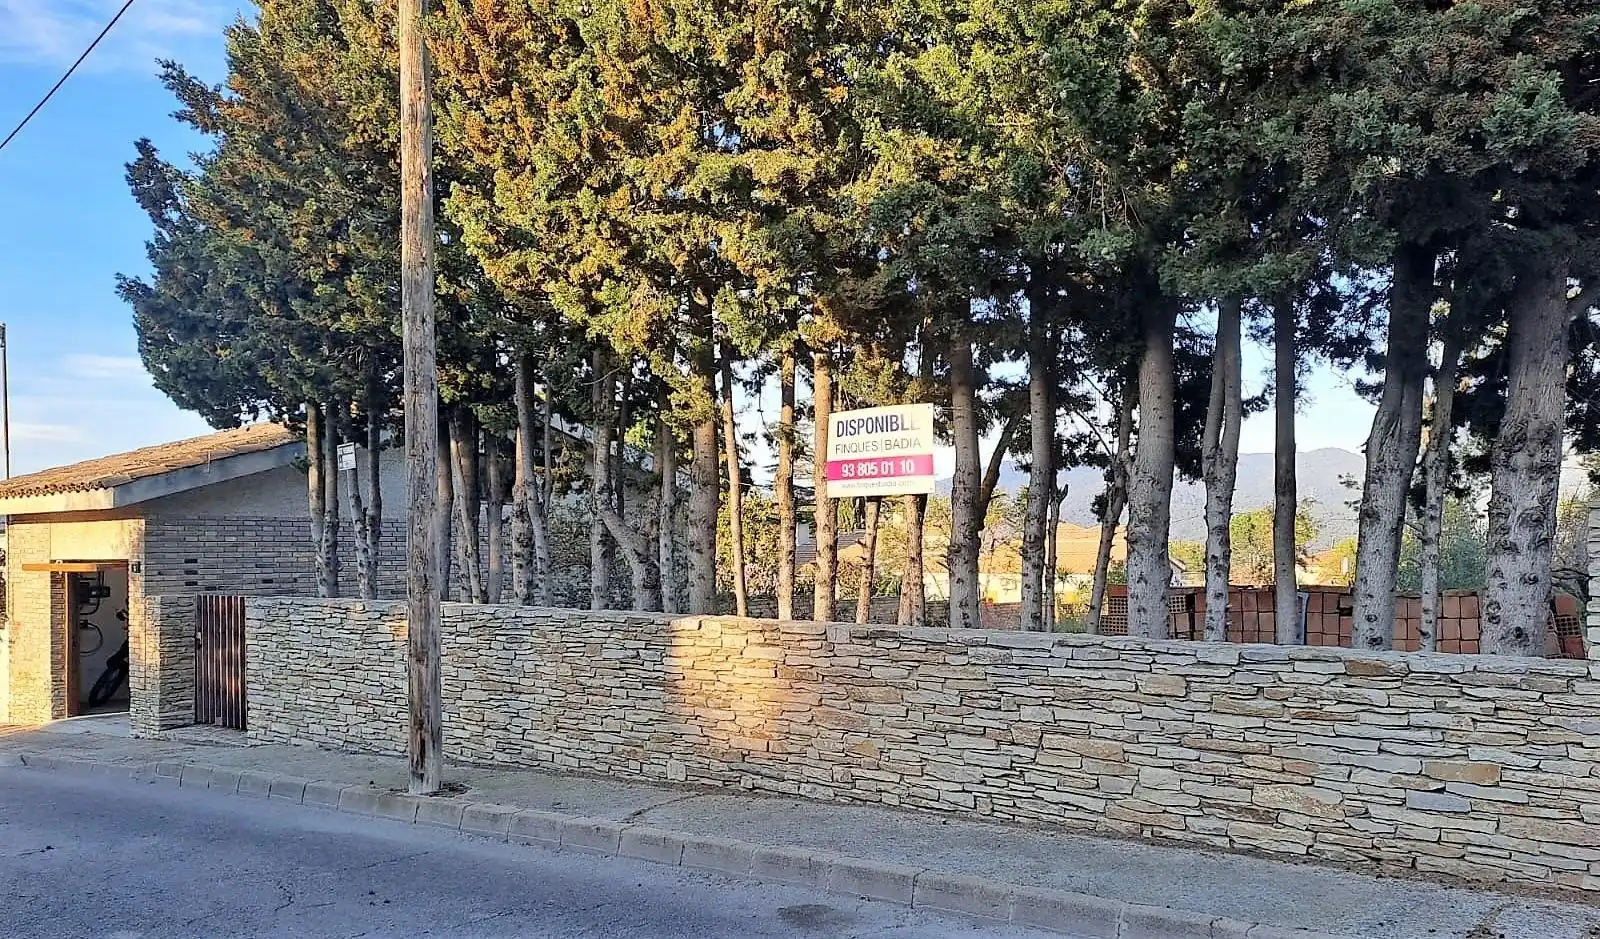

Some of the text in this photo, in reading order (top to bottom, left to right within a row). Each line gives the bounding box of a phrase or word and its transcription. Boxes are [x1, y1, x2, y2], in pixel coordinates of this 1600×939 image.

[835, 437, 922, 455] FINQUES BADIA
[841, 458, 914, 478] 93 805 01 10
